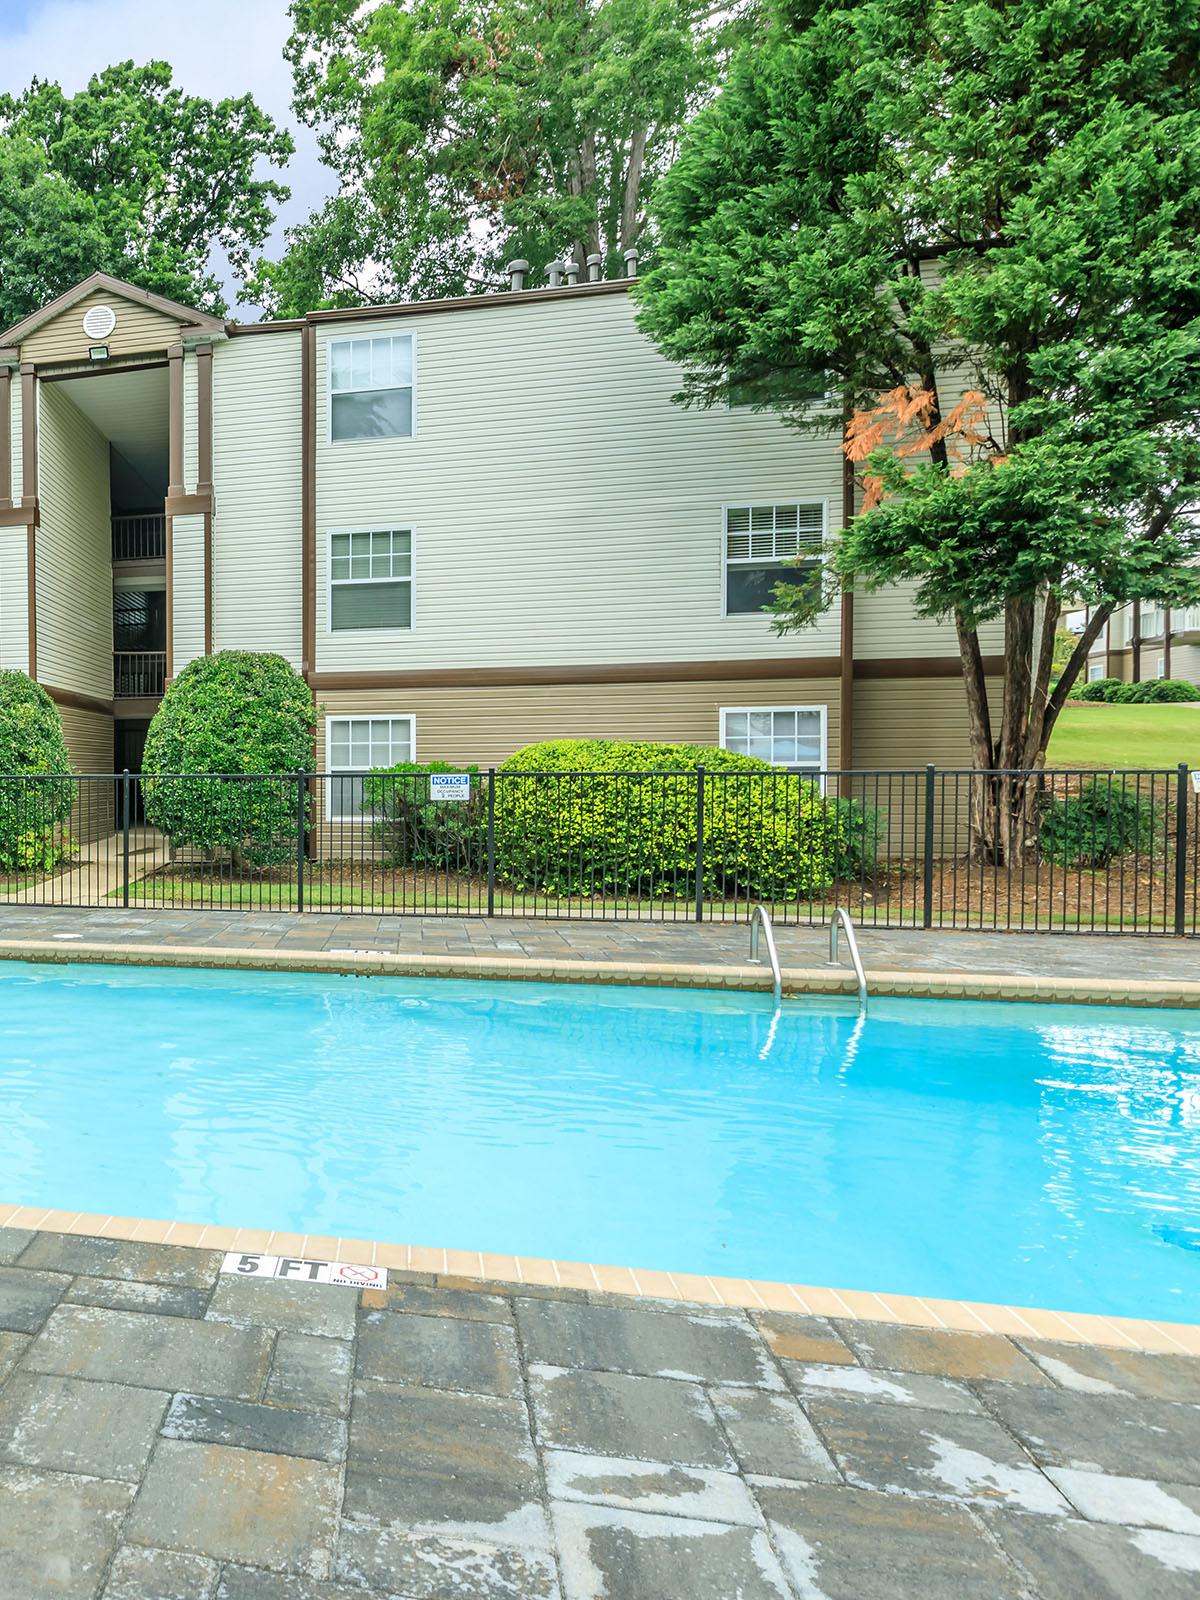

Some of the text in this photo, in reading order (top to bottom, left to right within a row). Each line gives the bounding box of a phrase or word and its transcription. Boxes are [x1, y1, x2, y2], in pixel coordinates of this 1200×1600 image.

[237, 1255, 329, 1280] 5 FT
[349, 1280, 383, 1289] DIVING
